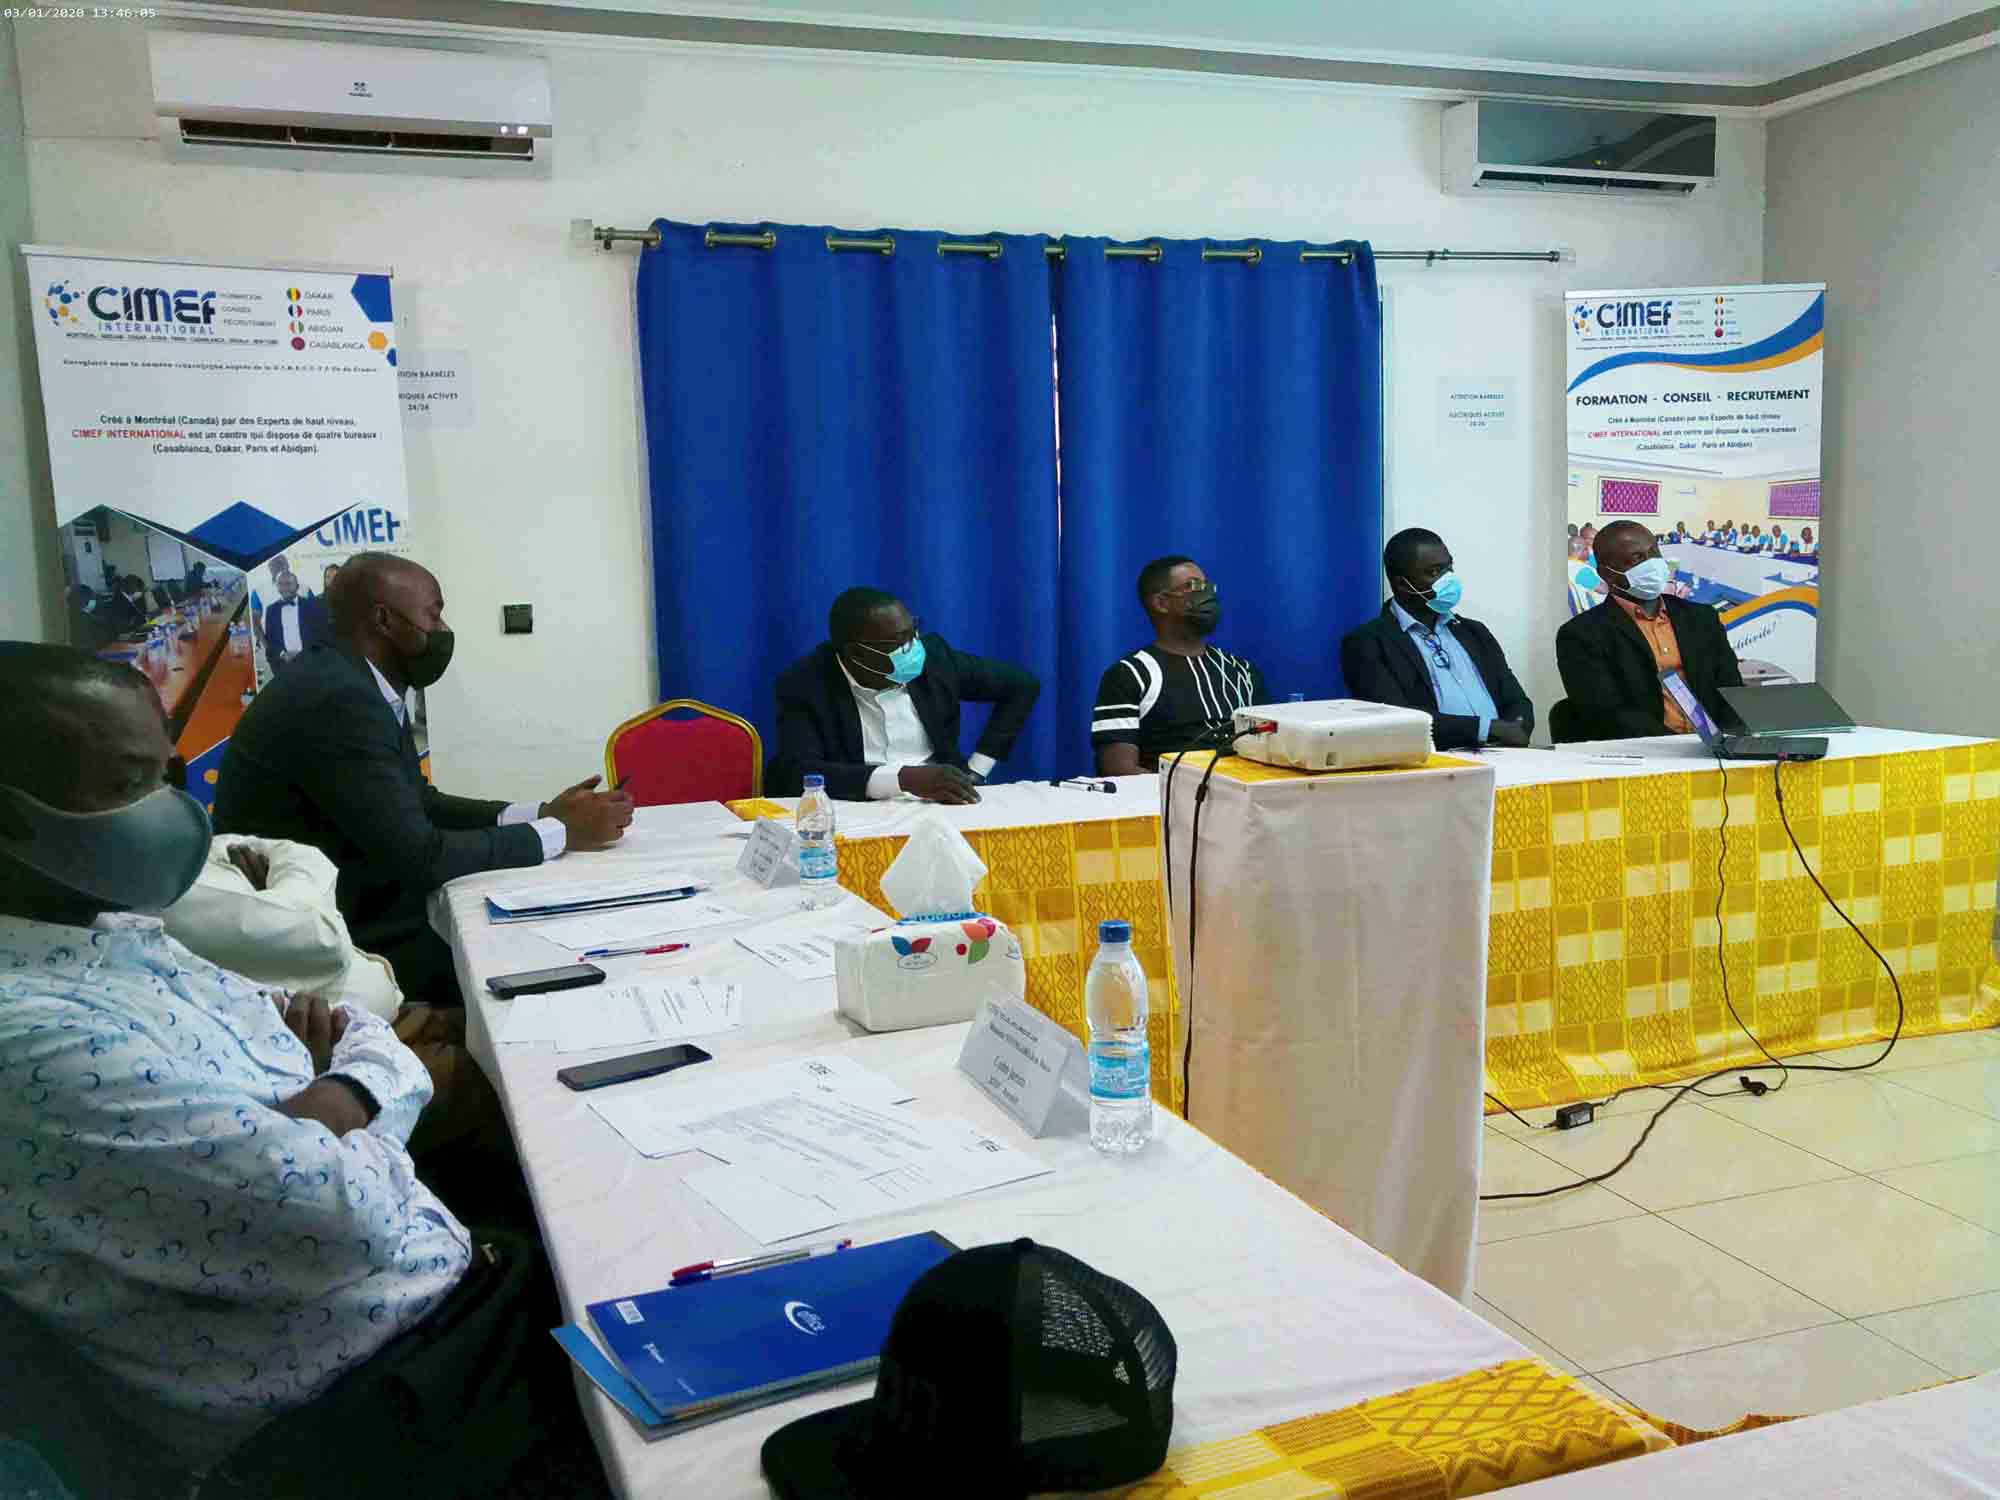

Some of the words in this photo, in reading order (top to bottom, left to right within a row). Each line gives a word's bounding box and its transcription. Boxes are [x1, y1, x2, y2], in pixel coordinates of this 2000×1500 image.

[304, 291, 334, 300] DAKAR
[87, 286, 217, 324] CIMEF
[306, 307, 331, 316] PARIS
[1596, 301, 1673, 329] CIMEF
[98, 322, 215, 335] INTERNATIONAL
[307, 324, 344, 333] ABIDJAN
[1600, 328, 1670, 336] INTERNATIONAL
[309, 340, 365, 350] CASABLANCA
[1576, 394, 1648, 407] FORMATION
[1663, 392, 1712, 403] CONSEIL
[1727, 389, 1810, 401] RECRUTEMENT
[134, 415, 176, 425] Montréal
[178, 415, 219, 427] (Canada)
[221, 417, 236, 428] par
[239, 416, 255, 426] des
[256, 416, 290, 428] Experts
[292, 417, 303, 426] de
[305, 417, 325, 426] haut
[71, 428, 103, 439] CIMEF
[106, 429, 186, 440] INTERNATIONAL
[188, 431, 203, 440] est
[205, 432, 217, 440] un
[219, 431, 248, 440] centre
[250, 431, 264, 442] qui
[266, 431, 300, 442] dispose
[302, 431, 313, 440] de
[315, 431, 342, 442] quatre
[343, 431, 377, 440] bureaux
[245, 445, 268, 454] Paris
[270, 445, 279, 453] et
